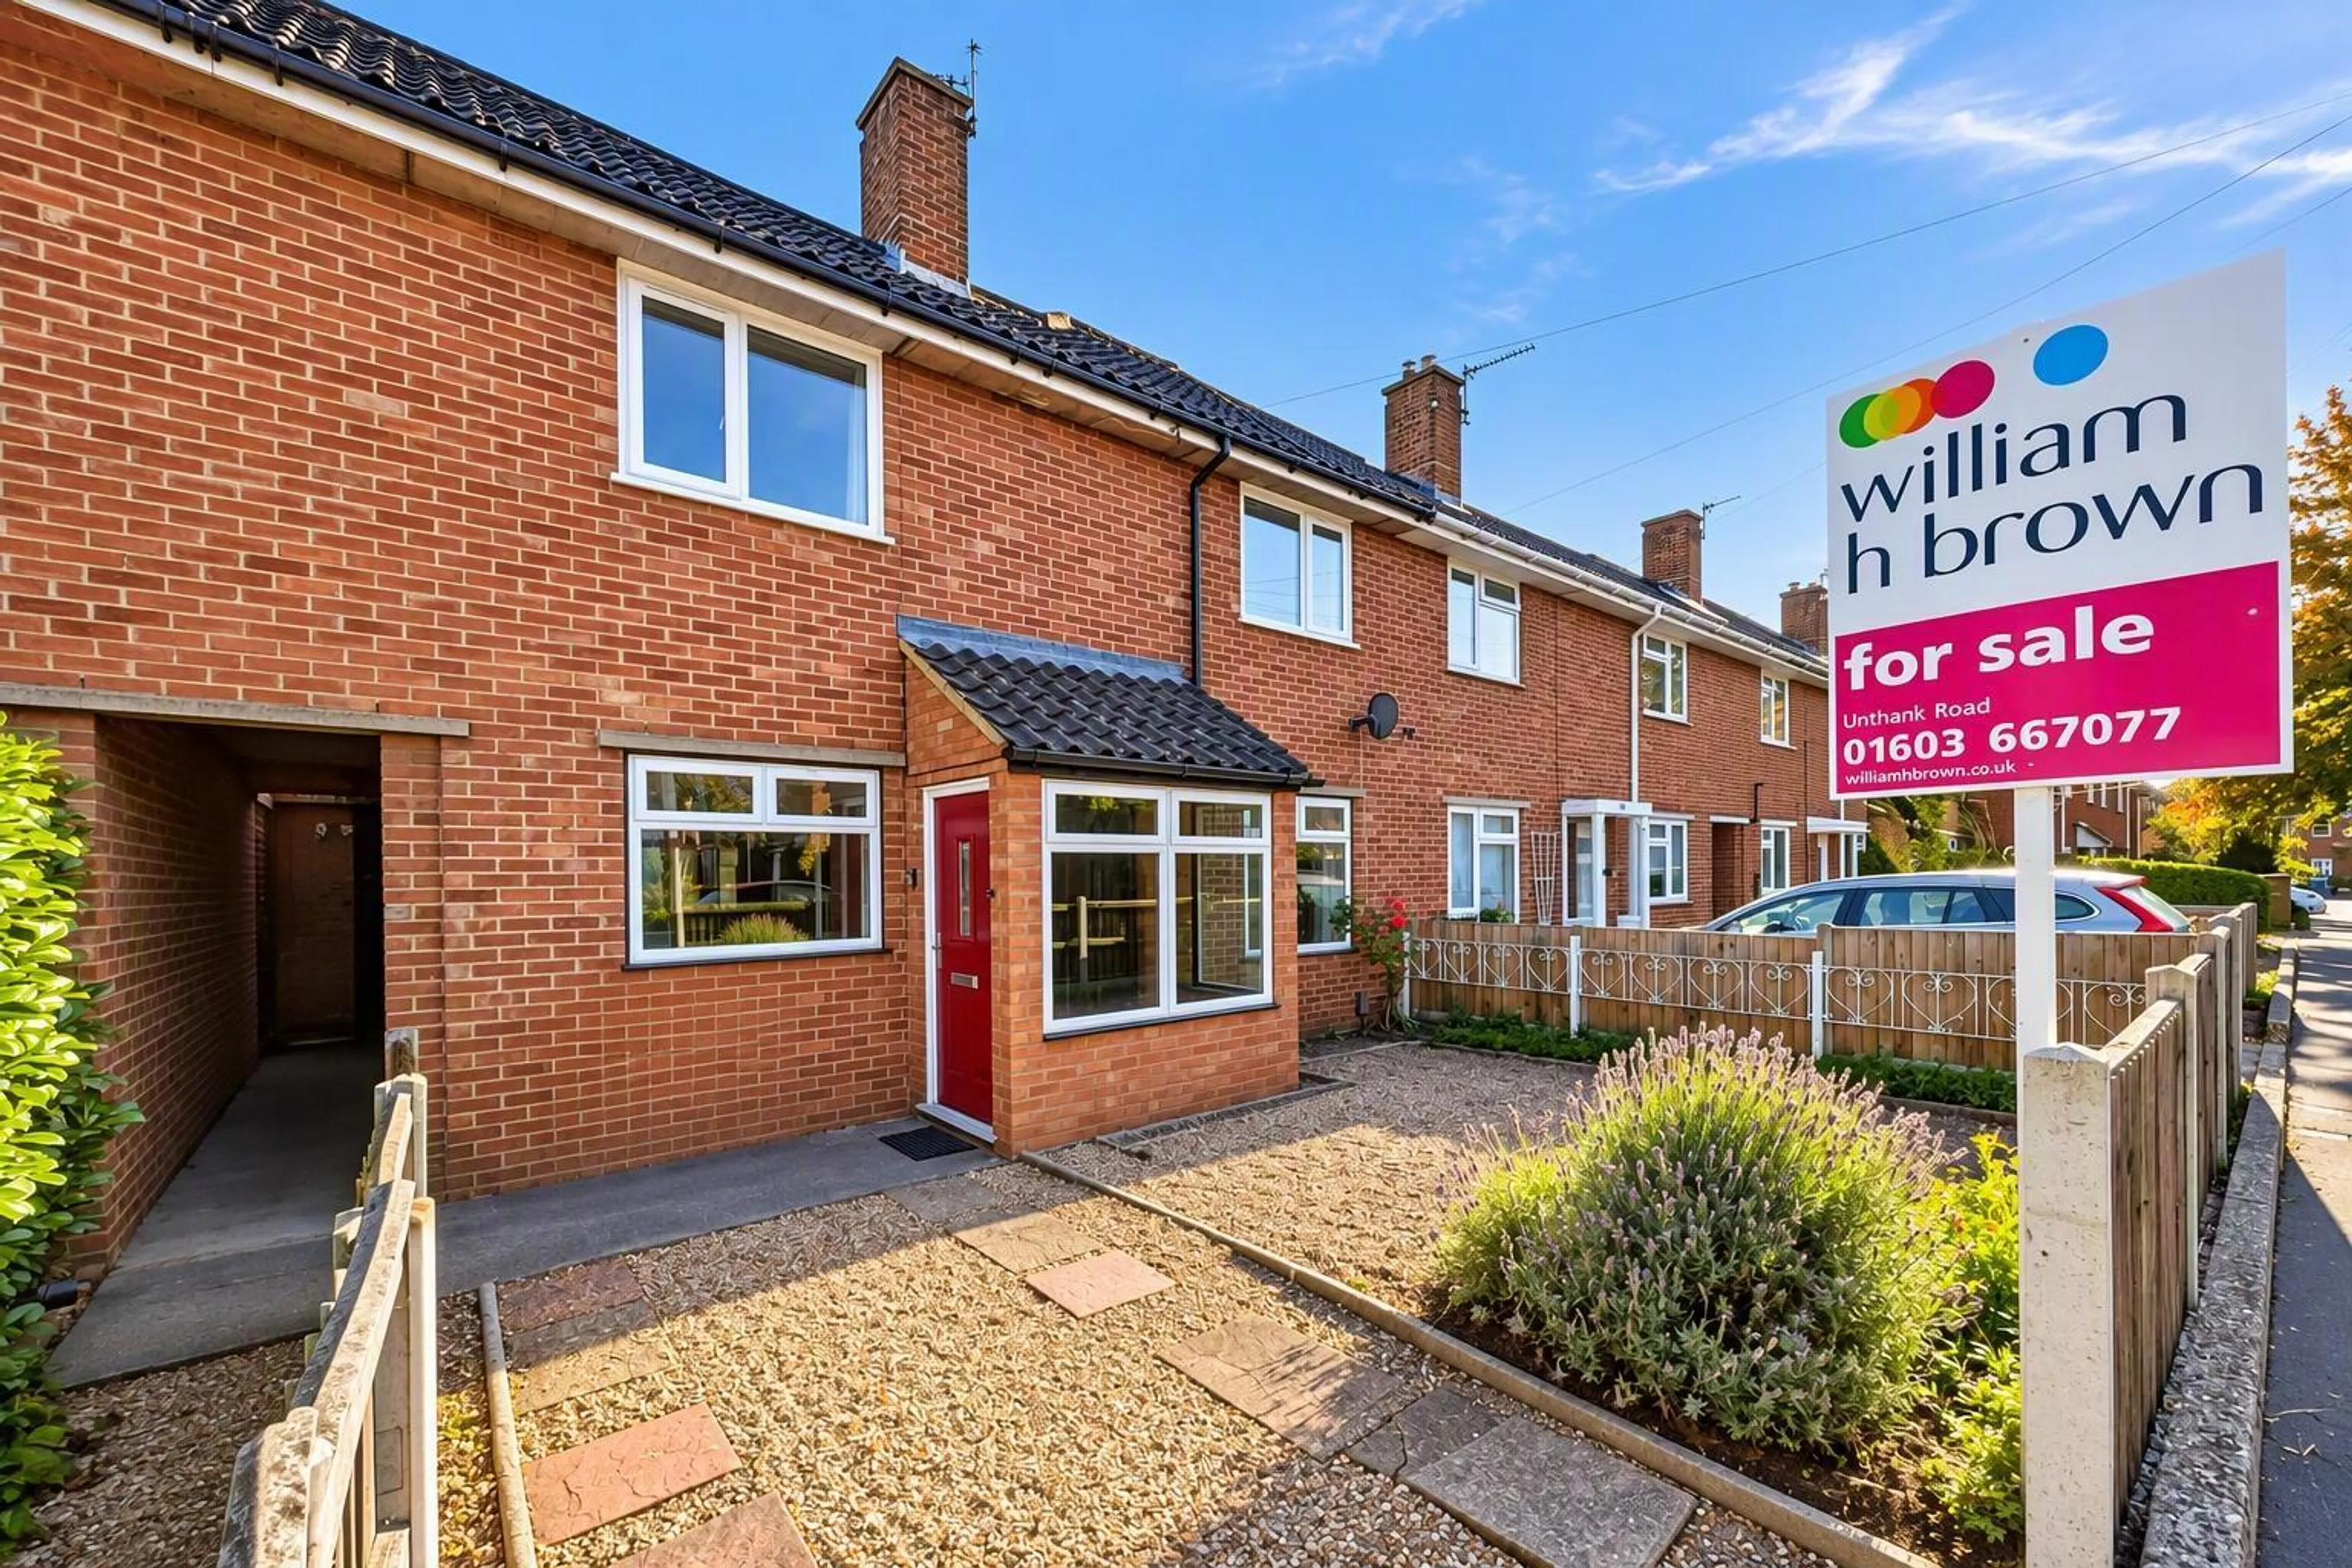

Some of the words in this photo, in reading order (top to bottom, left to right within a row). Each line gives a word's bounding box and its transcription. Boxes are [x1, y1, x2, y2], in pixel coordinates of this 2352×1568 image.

[1841, 394, 2187, 523] william
[1848, 532, 1891, 595] h
[1923, 464, 2263, 578] brown
[1844, 642, 1953, 690] for
[1978, 605, 2155, 673] sale
[1843, 705, 1926, 728] Unthank
[1935, 696, 1991, 719] Road
[1843, 728, 1966, 765] 01603
[1988, 706, 2182, 753] 667077
[1845, 760, 2016, 785] williamhbrown.co.uk
